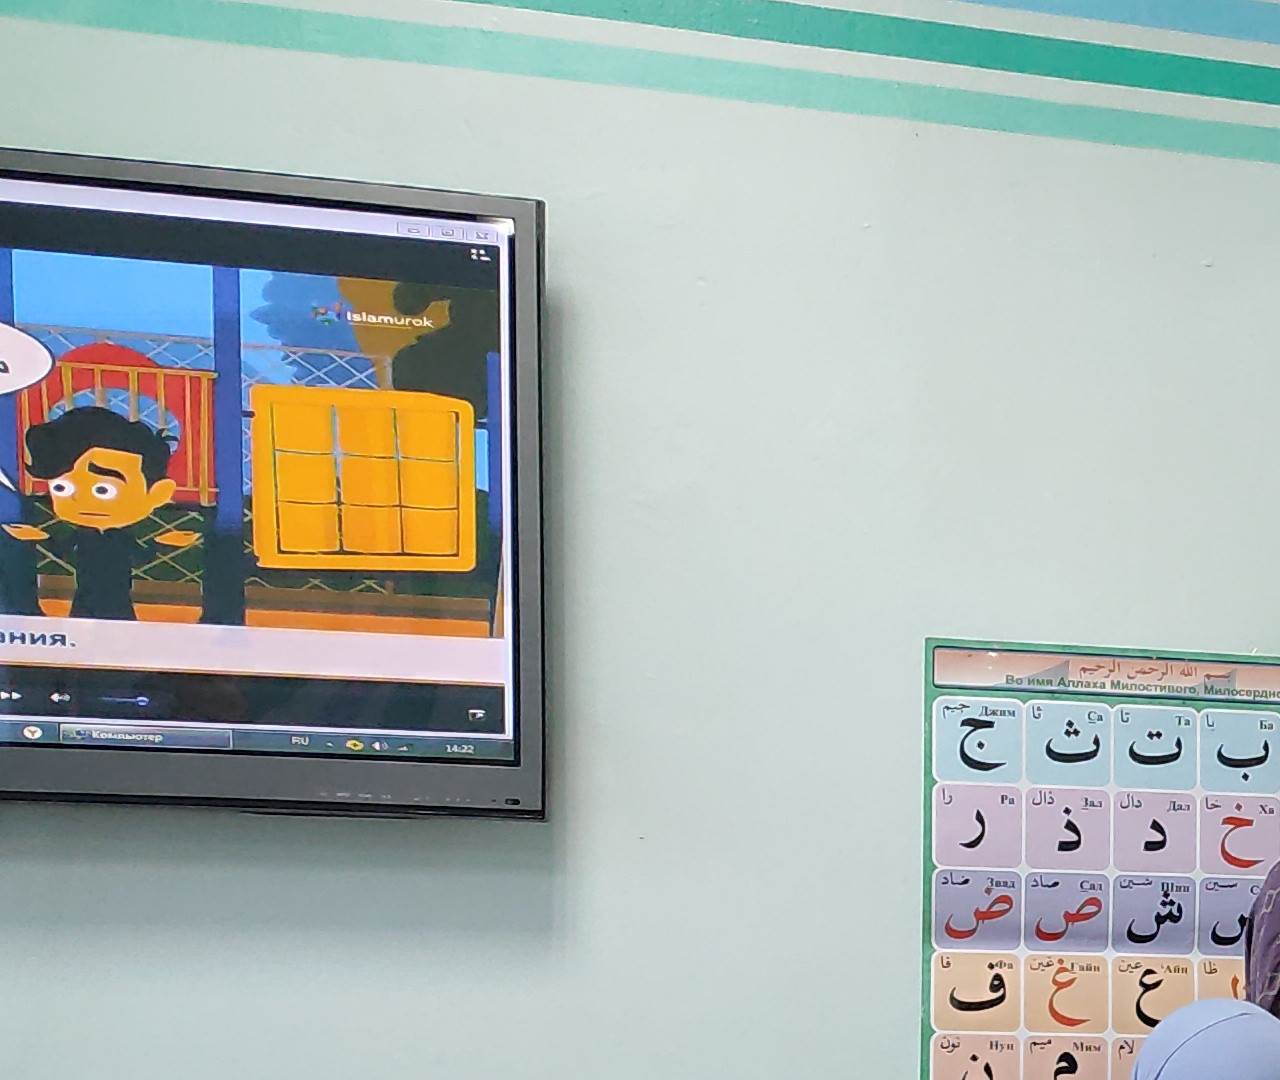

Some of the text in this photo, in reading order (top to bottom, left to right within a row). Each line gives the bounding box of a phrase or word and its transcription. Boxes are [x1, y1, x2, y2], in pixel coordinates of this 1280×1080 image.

[346, 311, 435, 329] Islamurok
[1006, 674, 1024, 686] Во
[1028, 678, 1054, 688] имя
[1057, 677, 1106, 691] Аллаха
[979, 706, 1016, 718] Джим
[1175, 715, 1191, 727] Та
[1259, 719, 1274, 730] Ба
[291, 736, 310, 746] RU
[960, 717, 1007, 771] ج
[1045, 719, 1101, 763] ث
[1128, 730, 1183, 766] ت
[1216, 739, 1270, 782] ب
[1000, 794, 1016, 805] Ра
[959, 809, 986, 849] ر
[1057, 806, 1082, 852] ذ
[1143, 818, 1167, 852] د
[1220, 802, 1265, 868] خ
[944, 887, 1014, 940] ض
[1035, 896, 1103, 942] ص
[1126, 890, 1184, 944] ش
[949, 961, 1007, 1012] ف
[1048, 958, 1091, 1027] غ
